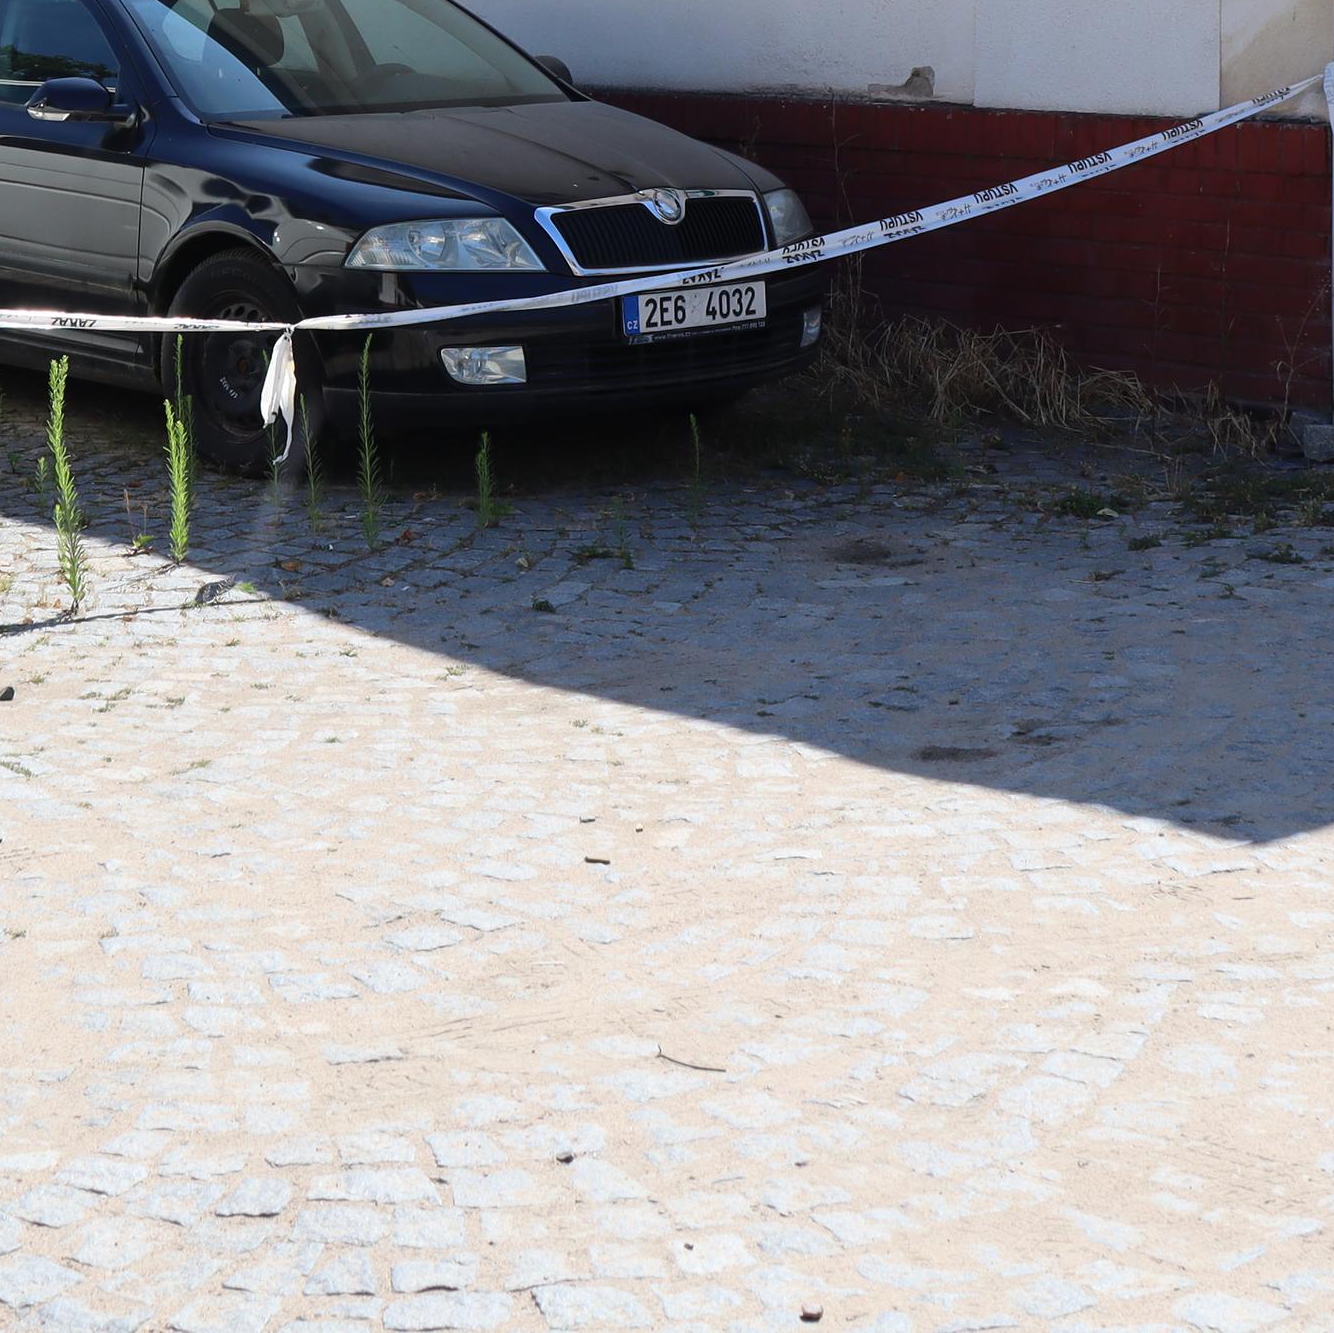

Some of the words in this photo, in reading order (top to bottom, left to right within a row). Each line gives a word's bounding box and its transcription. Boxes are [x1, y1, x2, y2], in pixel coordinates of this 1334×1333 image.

[1067, 152, 1113, 174] VSTUPU
[972, 182, 1019, 204] VSTUPU
[879, 211, 924, 231] VSTUPU
[644, 294, 687, 329] 2E6
[705, 285, 757, 321] 4032
[626, 320, 639, 331] CZ
